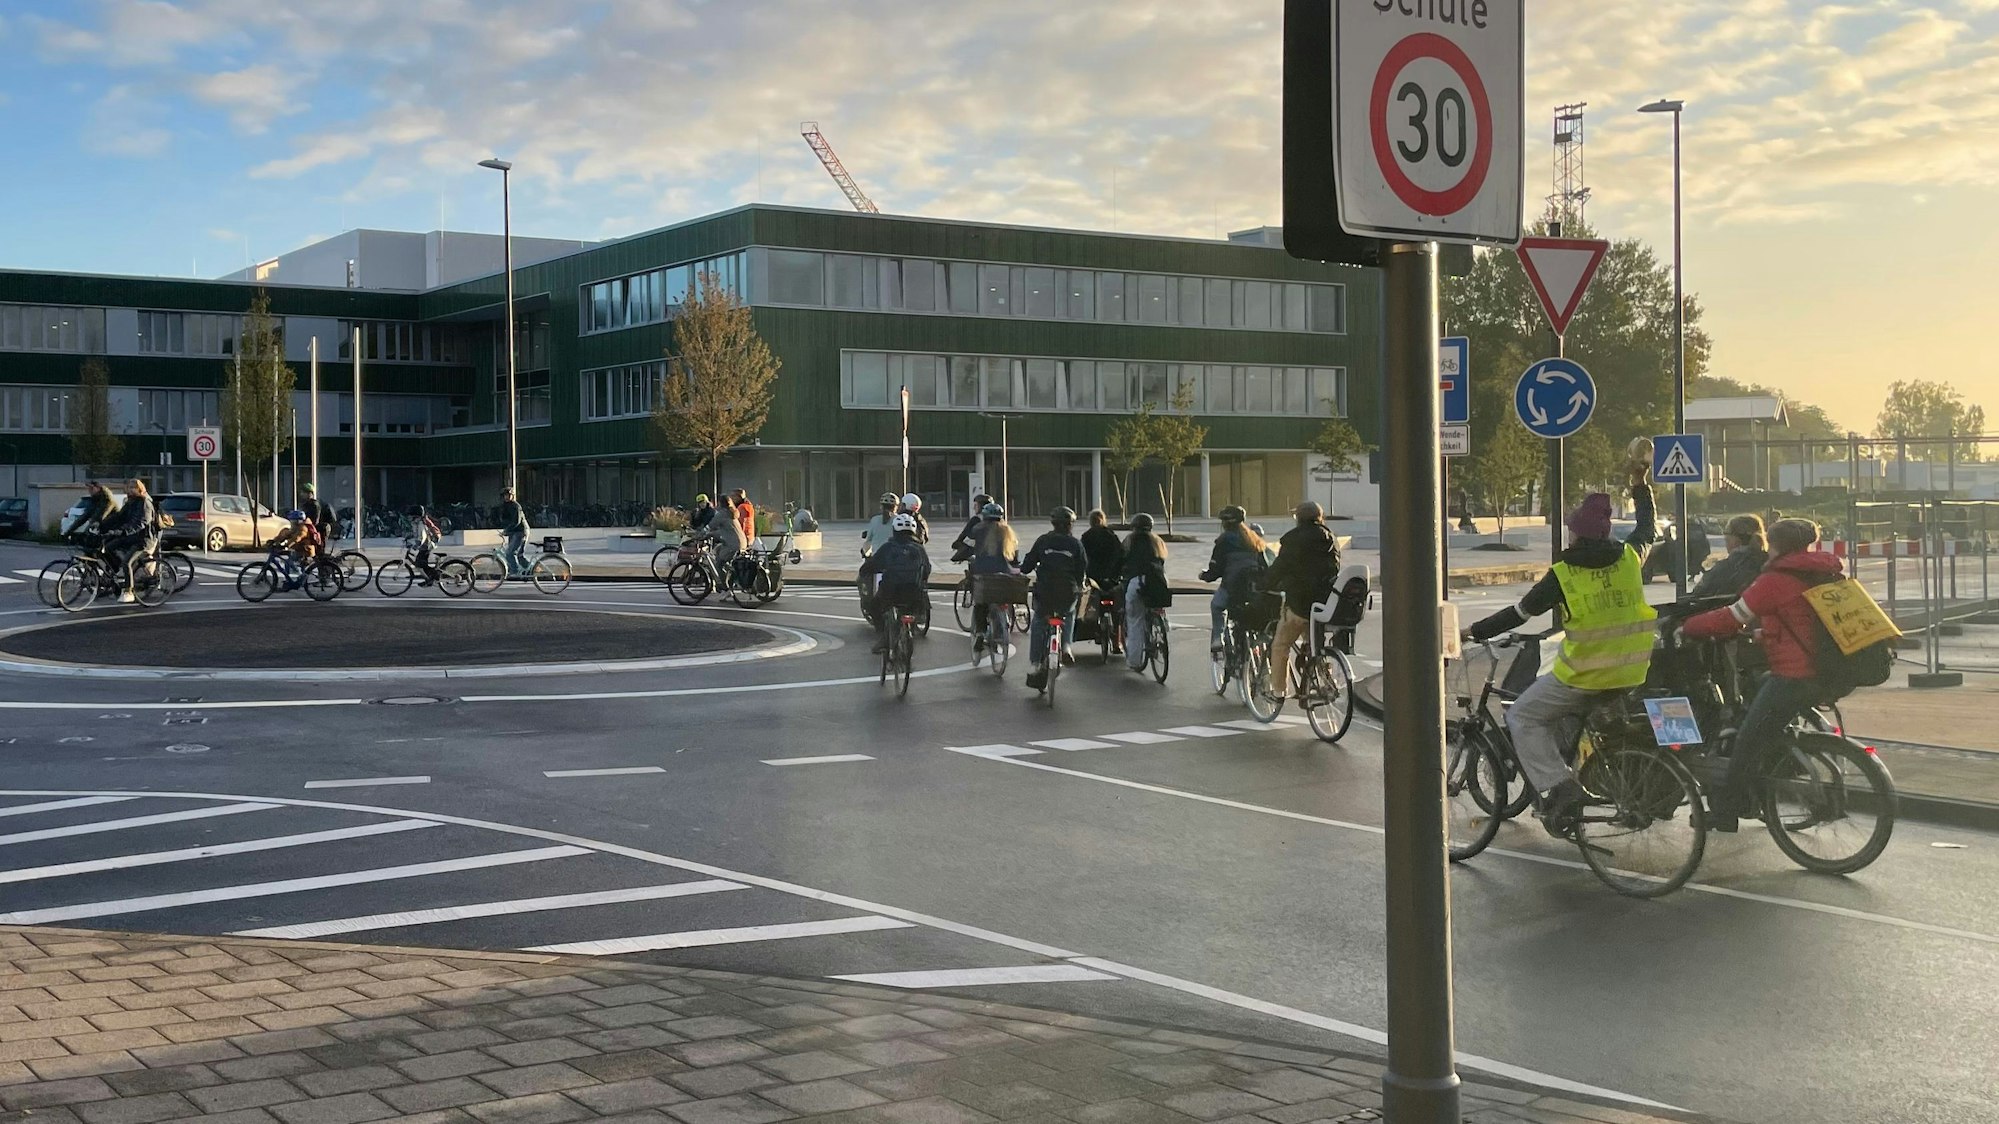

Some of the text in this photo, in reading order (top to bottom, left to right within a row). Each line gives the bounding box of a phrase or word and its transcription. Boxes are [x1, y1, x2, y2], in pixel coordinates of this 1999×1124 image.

[1373, 0, 1487, 28] cule
[1397, 82, 1467, 167] 30
[199, 441, 211, 451] 30
[1440, 442, 1461, 450] chkeit
